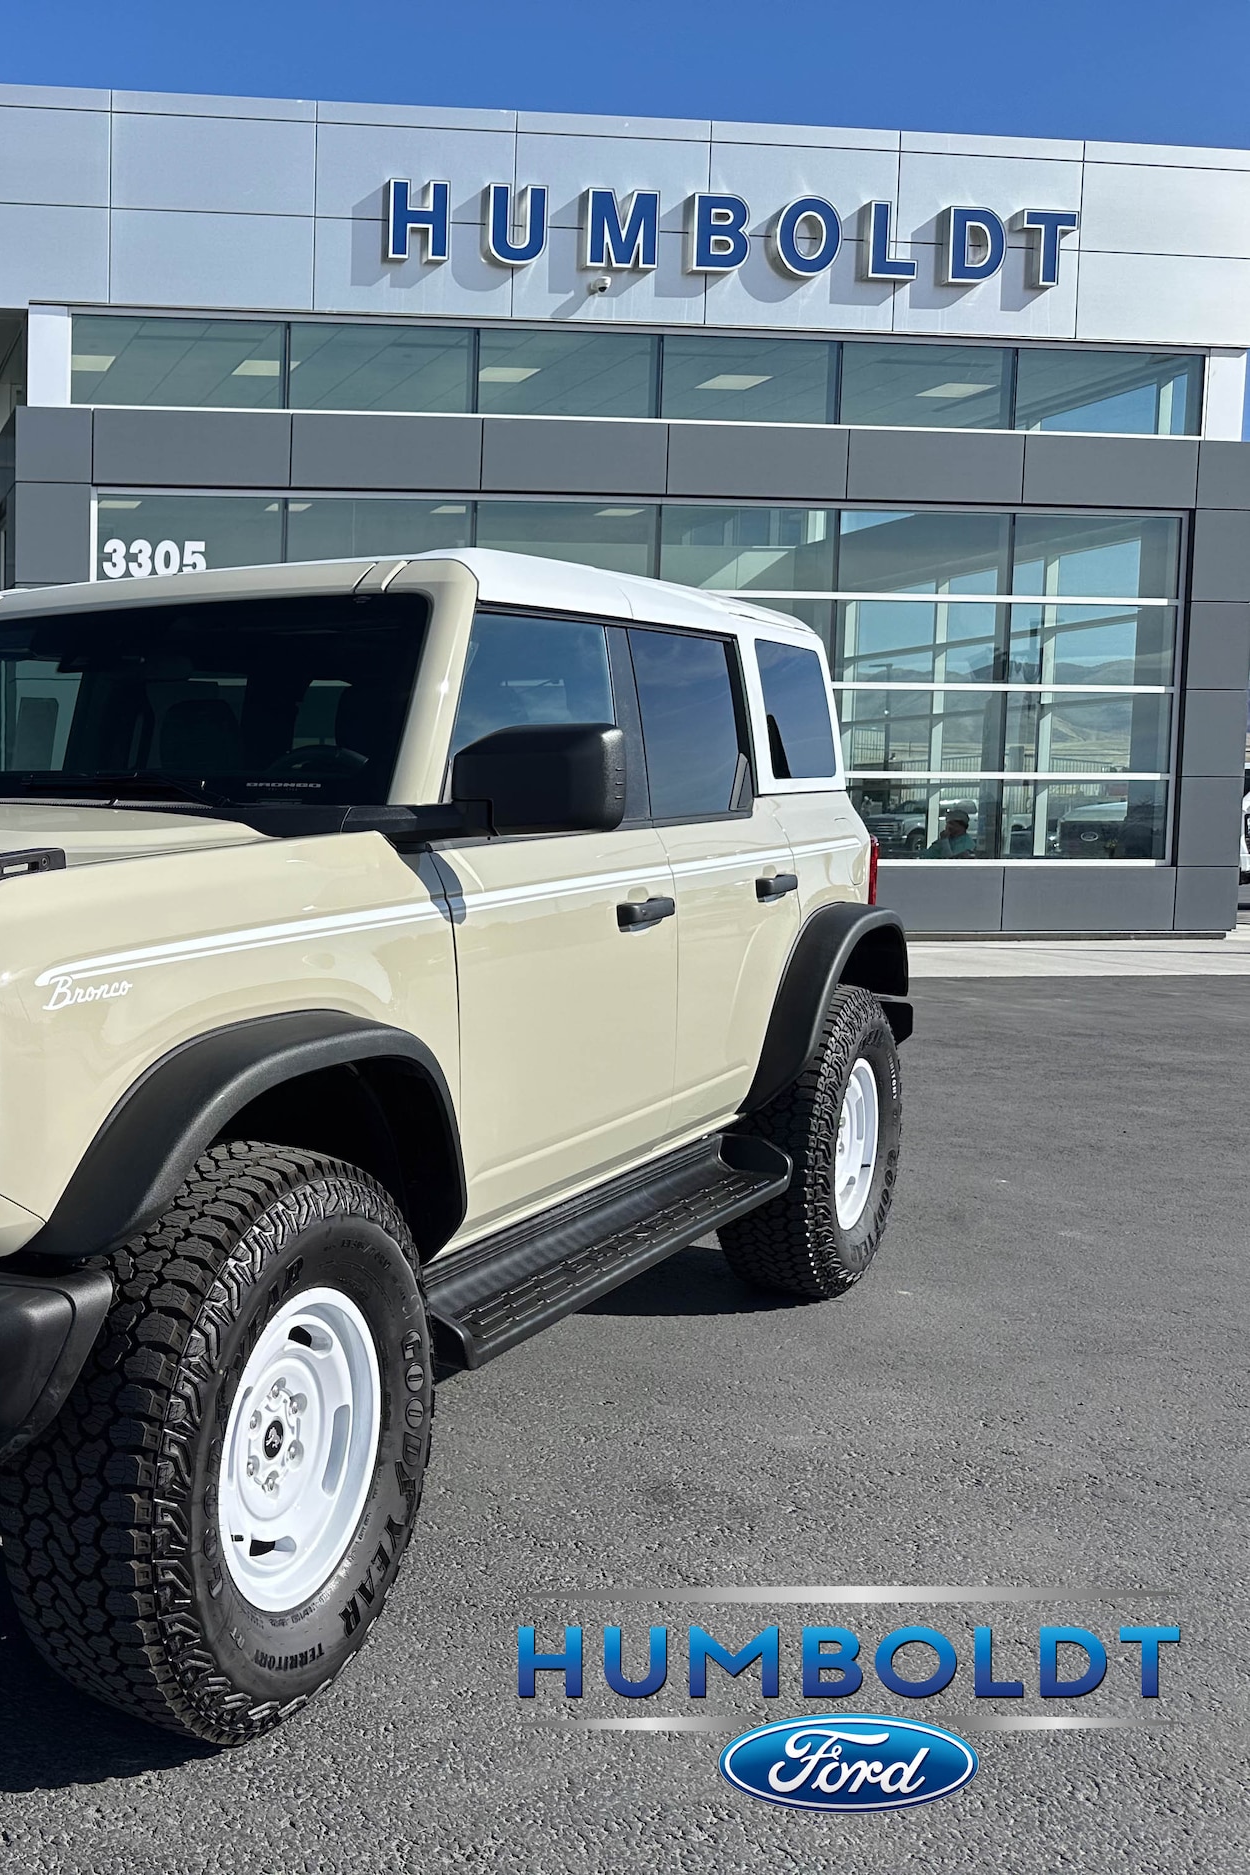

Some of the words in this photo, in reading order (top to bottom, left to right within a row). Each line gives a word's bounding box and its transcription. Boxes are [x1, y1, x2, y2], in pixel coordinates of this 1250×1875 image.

[386, 177, 1081, 288] HUMBOLDT
[102, 538, 207, 578] 3305
[42, 975, 134, 1011] Bronco
[254, 1632, 325, 1672] TERRITORY
